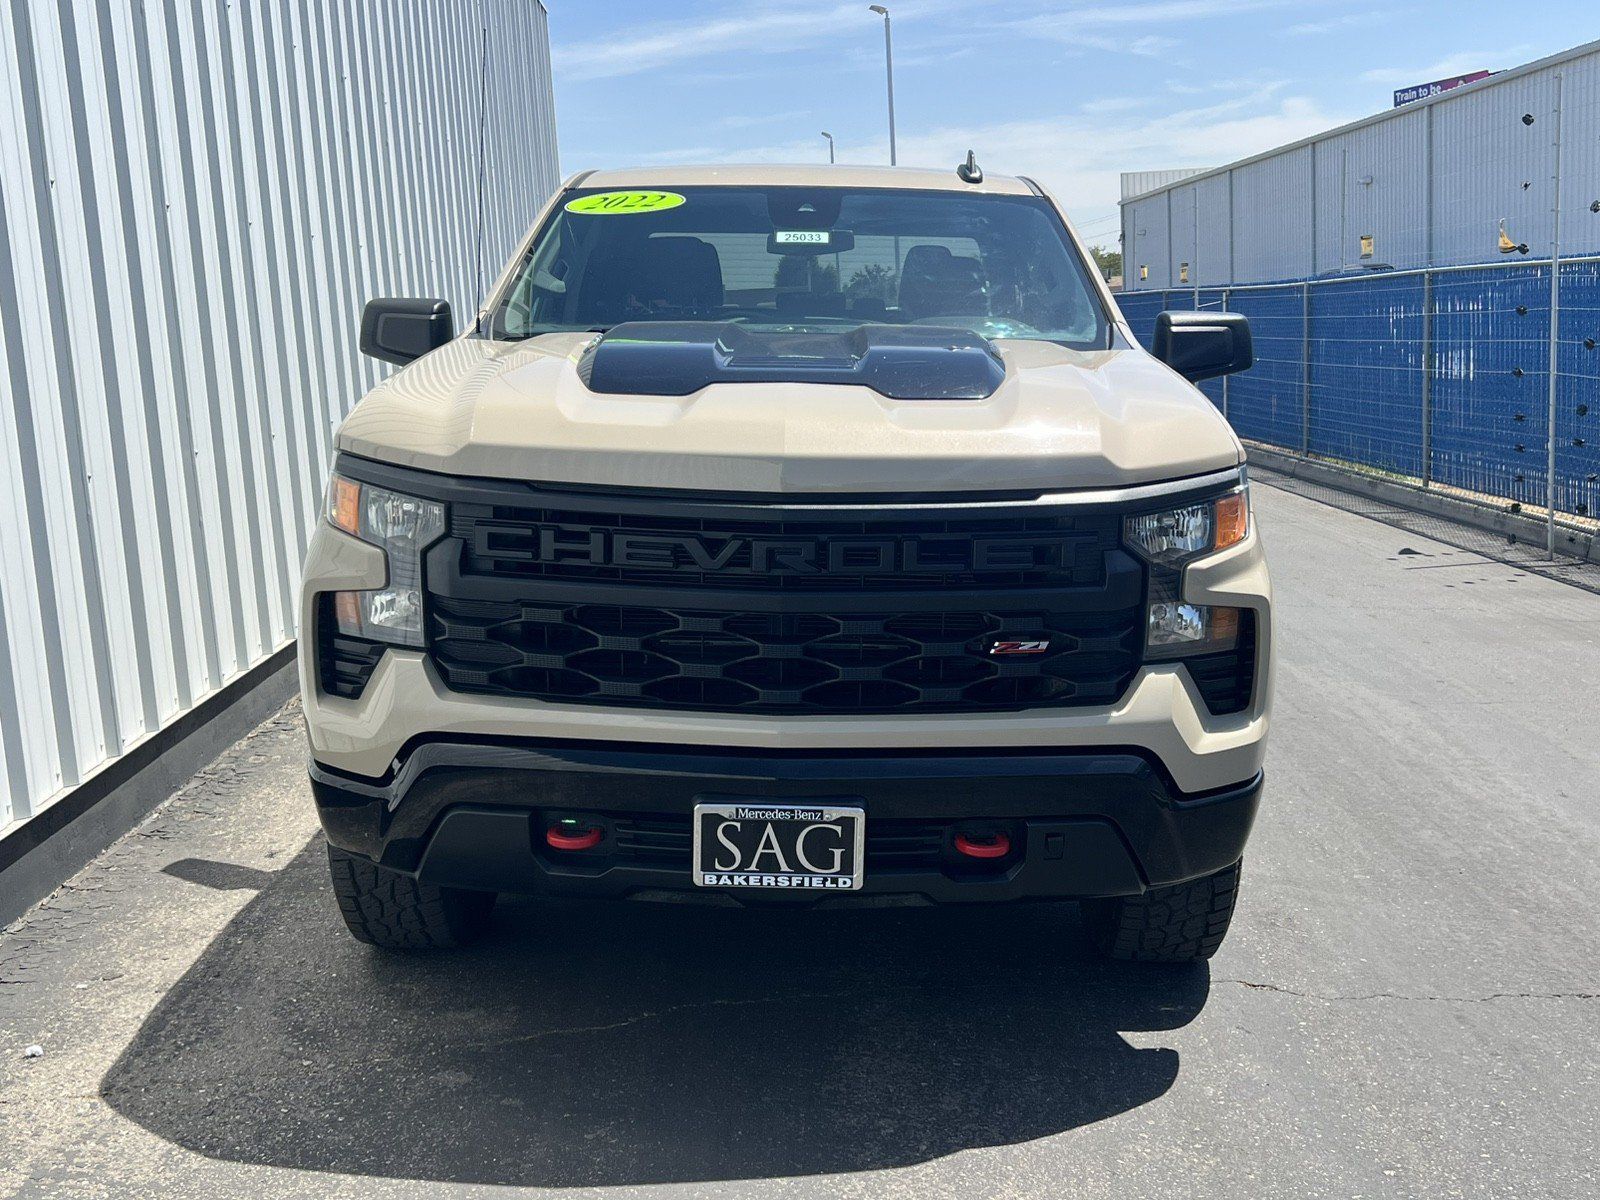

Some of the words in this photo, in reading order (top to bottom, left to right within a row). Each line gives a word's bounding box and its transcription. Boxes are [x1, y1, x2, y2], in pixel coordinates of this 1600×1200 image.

[1396, 90, 1417, 102] Train
[1419, 88, 1428, 97] to
[1430, 85, 1441, 95] be
[584, 195, 666, 209] 2022
[784, 233, 822, 242] 25033
[474, 520, 1096, 574] CHEVROLET
[738, 808, 822, 820] Mercedes-Benz
[714, 821, 846, 874] SAG
[704, 874, 853, 888] BAKERSFIELD
